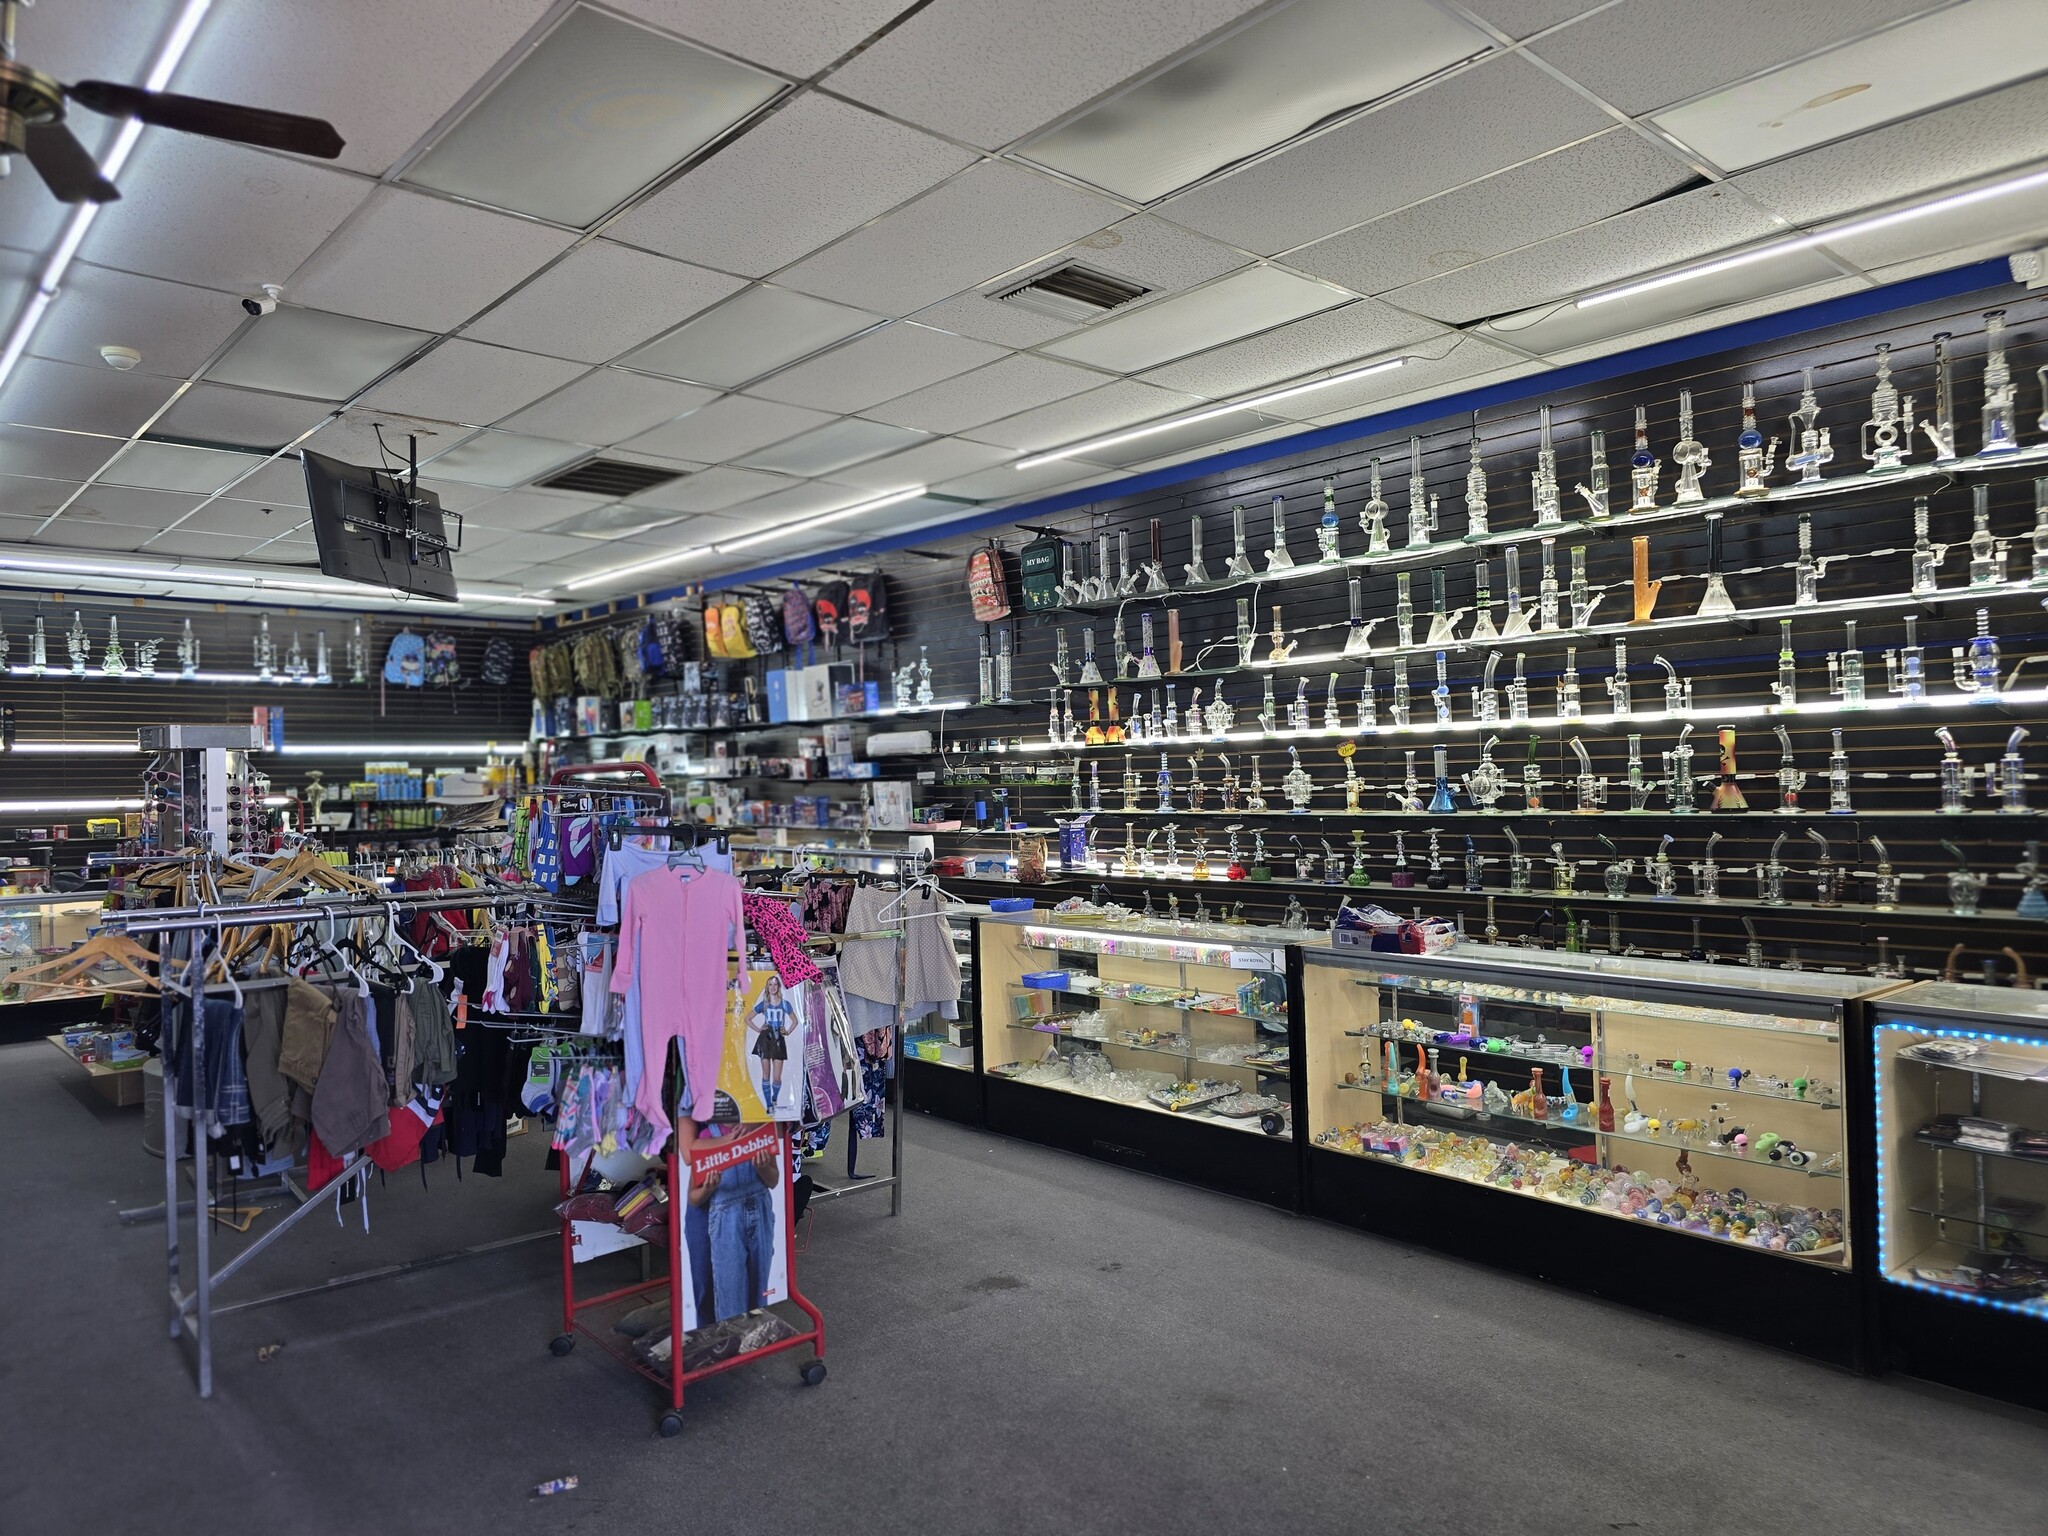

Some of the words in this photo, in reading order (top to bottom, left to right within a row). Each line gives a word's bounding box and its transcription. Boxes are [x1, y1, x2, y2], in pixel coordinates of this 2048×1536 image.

[1026, 559, 1036, 567] MY
[1036, 556, 1050, 564] BAG
[561, 801, 578, 809] Disney
[554, 927, 569, 935] Disney
[695, 1151, 731, 1173] Little
[731, 1134, 775, 1159] Debbie
